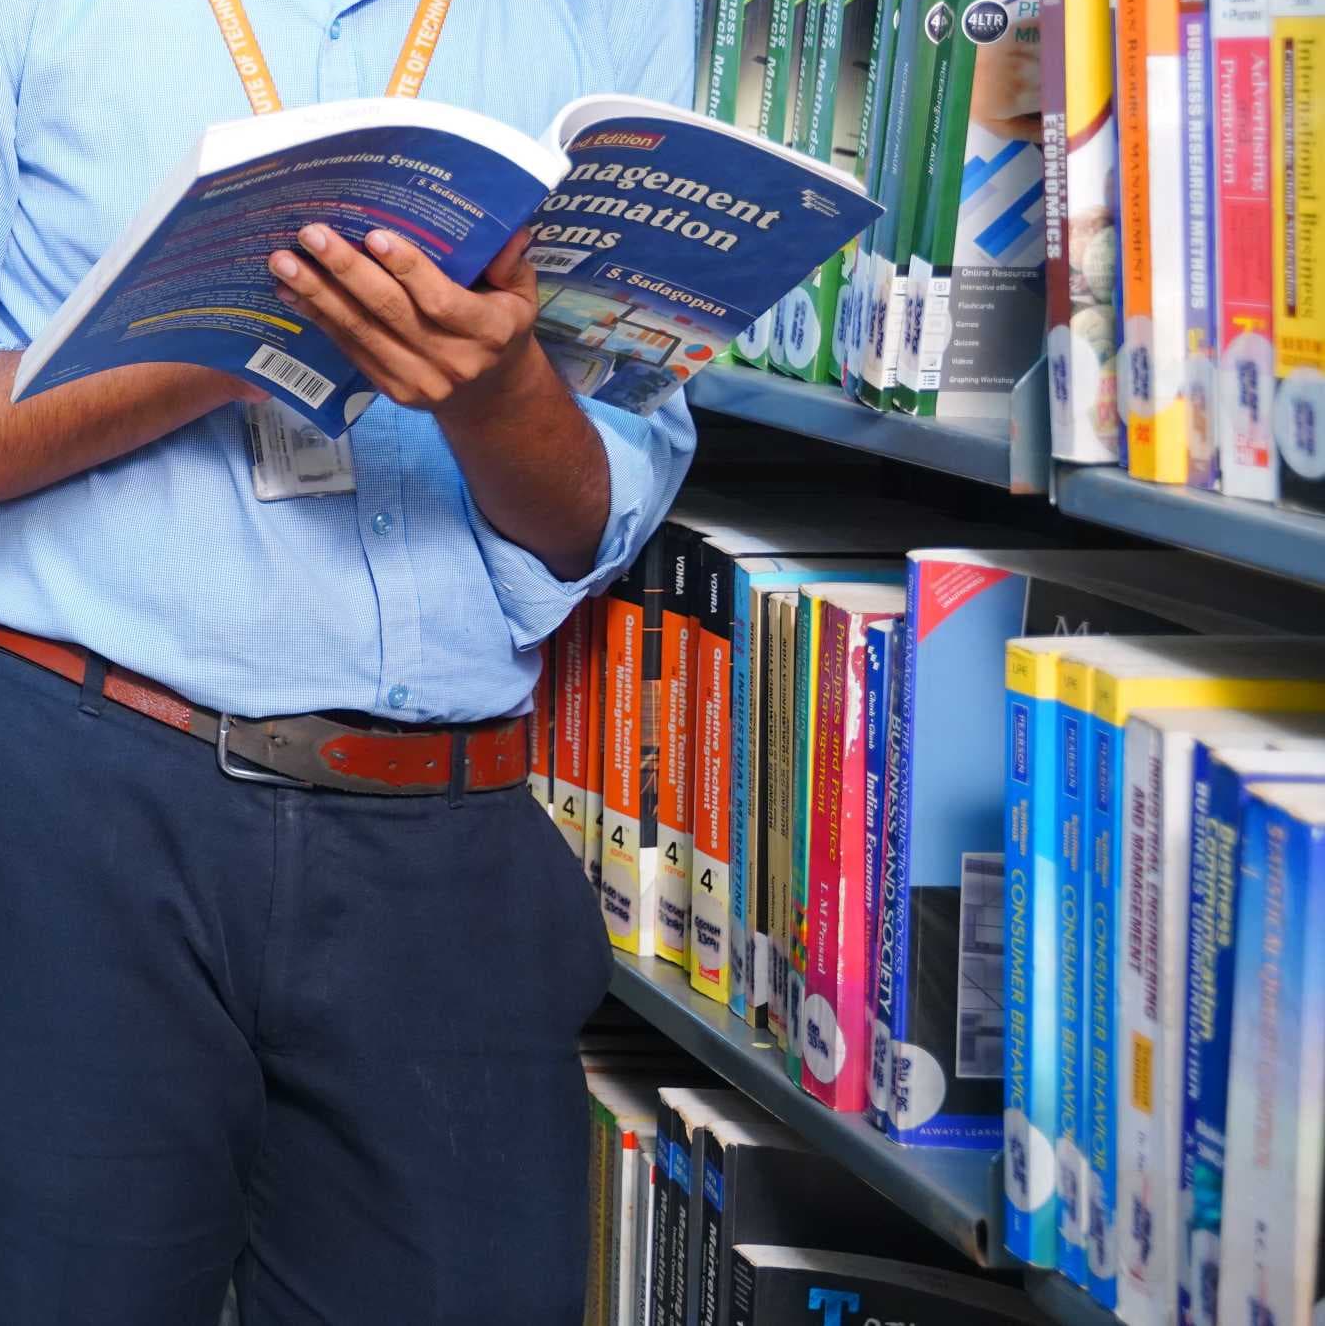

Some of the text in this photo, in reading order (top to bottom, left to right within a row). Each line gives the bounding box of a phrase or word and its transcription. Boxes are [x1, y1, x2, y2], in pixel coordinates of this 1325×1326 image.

[233, 52, 259, 77] OF
[404, 51, 427, 73] OF
[967, 12, 1004, 26] 4LTR
[1187, 24, 1204, 114] BUSINESS
[808, 56, 828, 157] Methods
[857, 57, 877, 160] Methods
[1126, 38, 1140, 132] RESOURCE
[1220, 59, 1238, 187] Promotion
[1251, 50, 1270, 194] Advertising
[1297, 38, 1317, 201] International
[202, 166, 292, 201] Management
[293, 152, 385, 174] Information
[386, 153, 454, 182] Systems
[570, 133, 654, 151] nd Edition
[1044, 113, 1063, 260] ECONOMICS
[1188, 115, 1206, 216] RESEARCH
[428, 182, 487, 220] Sadagopan
[533, 185, 739, 253] ormation
[568, 160, 781, 230] nagement
[1129, 141, 1145, 283] MANAGEMENT
[606, 267, 728, 319] S. Sadagopan
[958, 301, 996, 311] Flashcards
[961, 268, 1040, 279] Online Resources
[1189, 220, 1207, 310] METHODS
[951, 357, 975, 366] Videos
[955, 320, 981, 330] Games
[948, 375, 1016, 387] Graphing Workshop
[675, 555, 687, 596] VOHRA
[709, 572, 719, 614] VOHRA
[613, 665, 625, 771] Management
[621, 614, 636, 808] Quantitative Techniques
[667, 678, 680, 787] Management
[676, 627, 690, 823] Quantitative Techniques
[703, 700, 714, 811] Management
[710, 647, 723, 851] Quantitative Techniques
[817, 679, 830, 814] Management
[827, 624, 846, 862] Principles and Practice
[1015, 712, 1026, 776] PEARSON
[732, 672, 747, 920] INDUSTRIAL MARKETING
[864, 770, 879, 911] Indian Economy
[895, 624, 915, 976] MANAGING THE CONSTRUCTION PROCESS
[877, 713, 902, 1016] BUSINESS AND SOCIETY
[1128, 784, 1146, 974] AND MANAGEMENT
[1145, 754, 1161, 1022] INDUSTRIAL ENGINEERING
[1214, 821, 1238, 948] Business
[817, 921, 828, 976] Prasad
[1187, 781, 1211, 1101] BUSINESS COMMUNICATION
[1198, 817, 1224, 1043] Communication
[1092, 901, 1110, 1171] CONSUMER BEHAVIOR
[919, 1127, 1004, 1139] ALWAYS LEARNI
[655, 1189, 668, 1295] Marketing
[674, 1205, 687, 1324] Marketing
